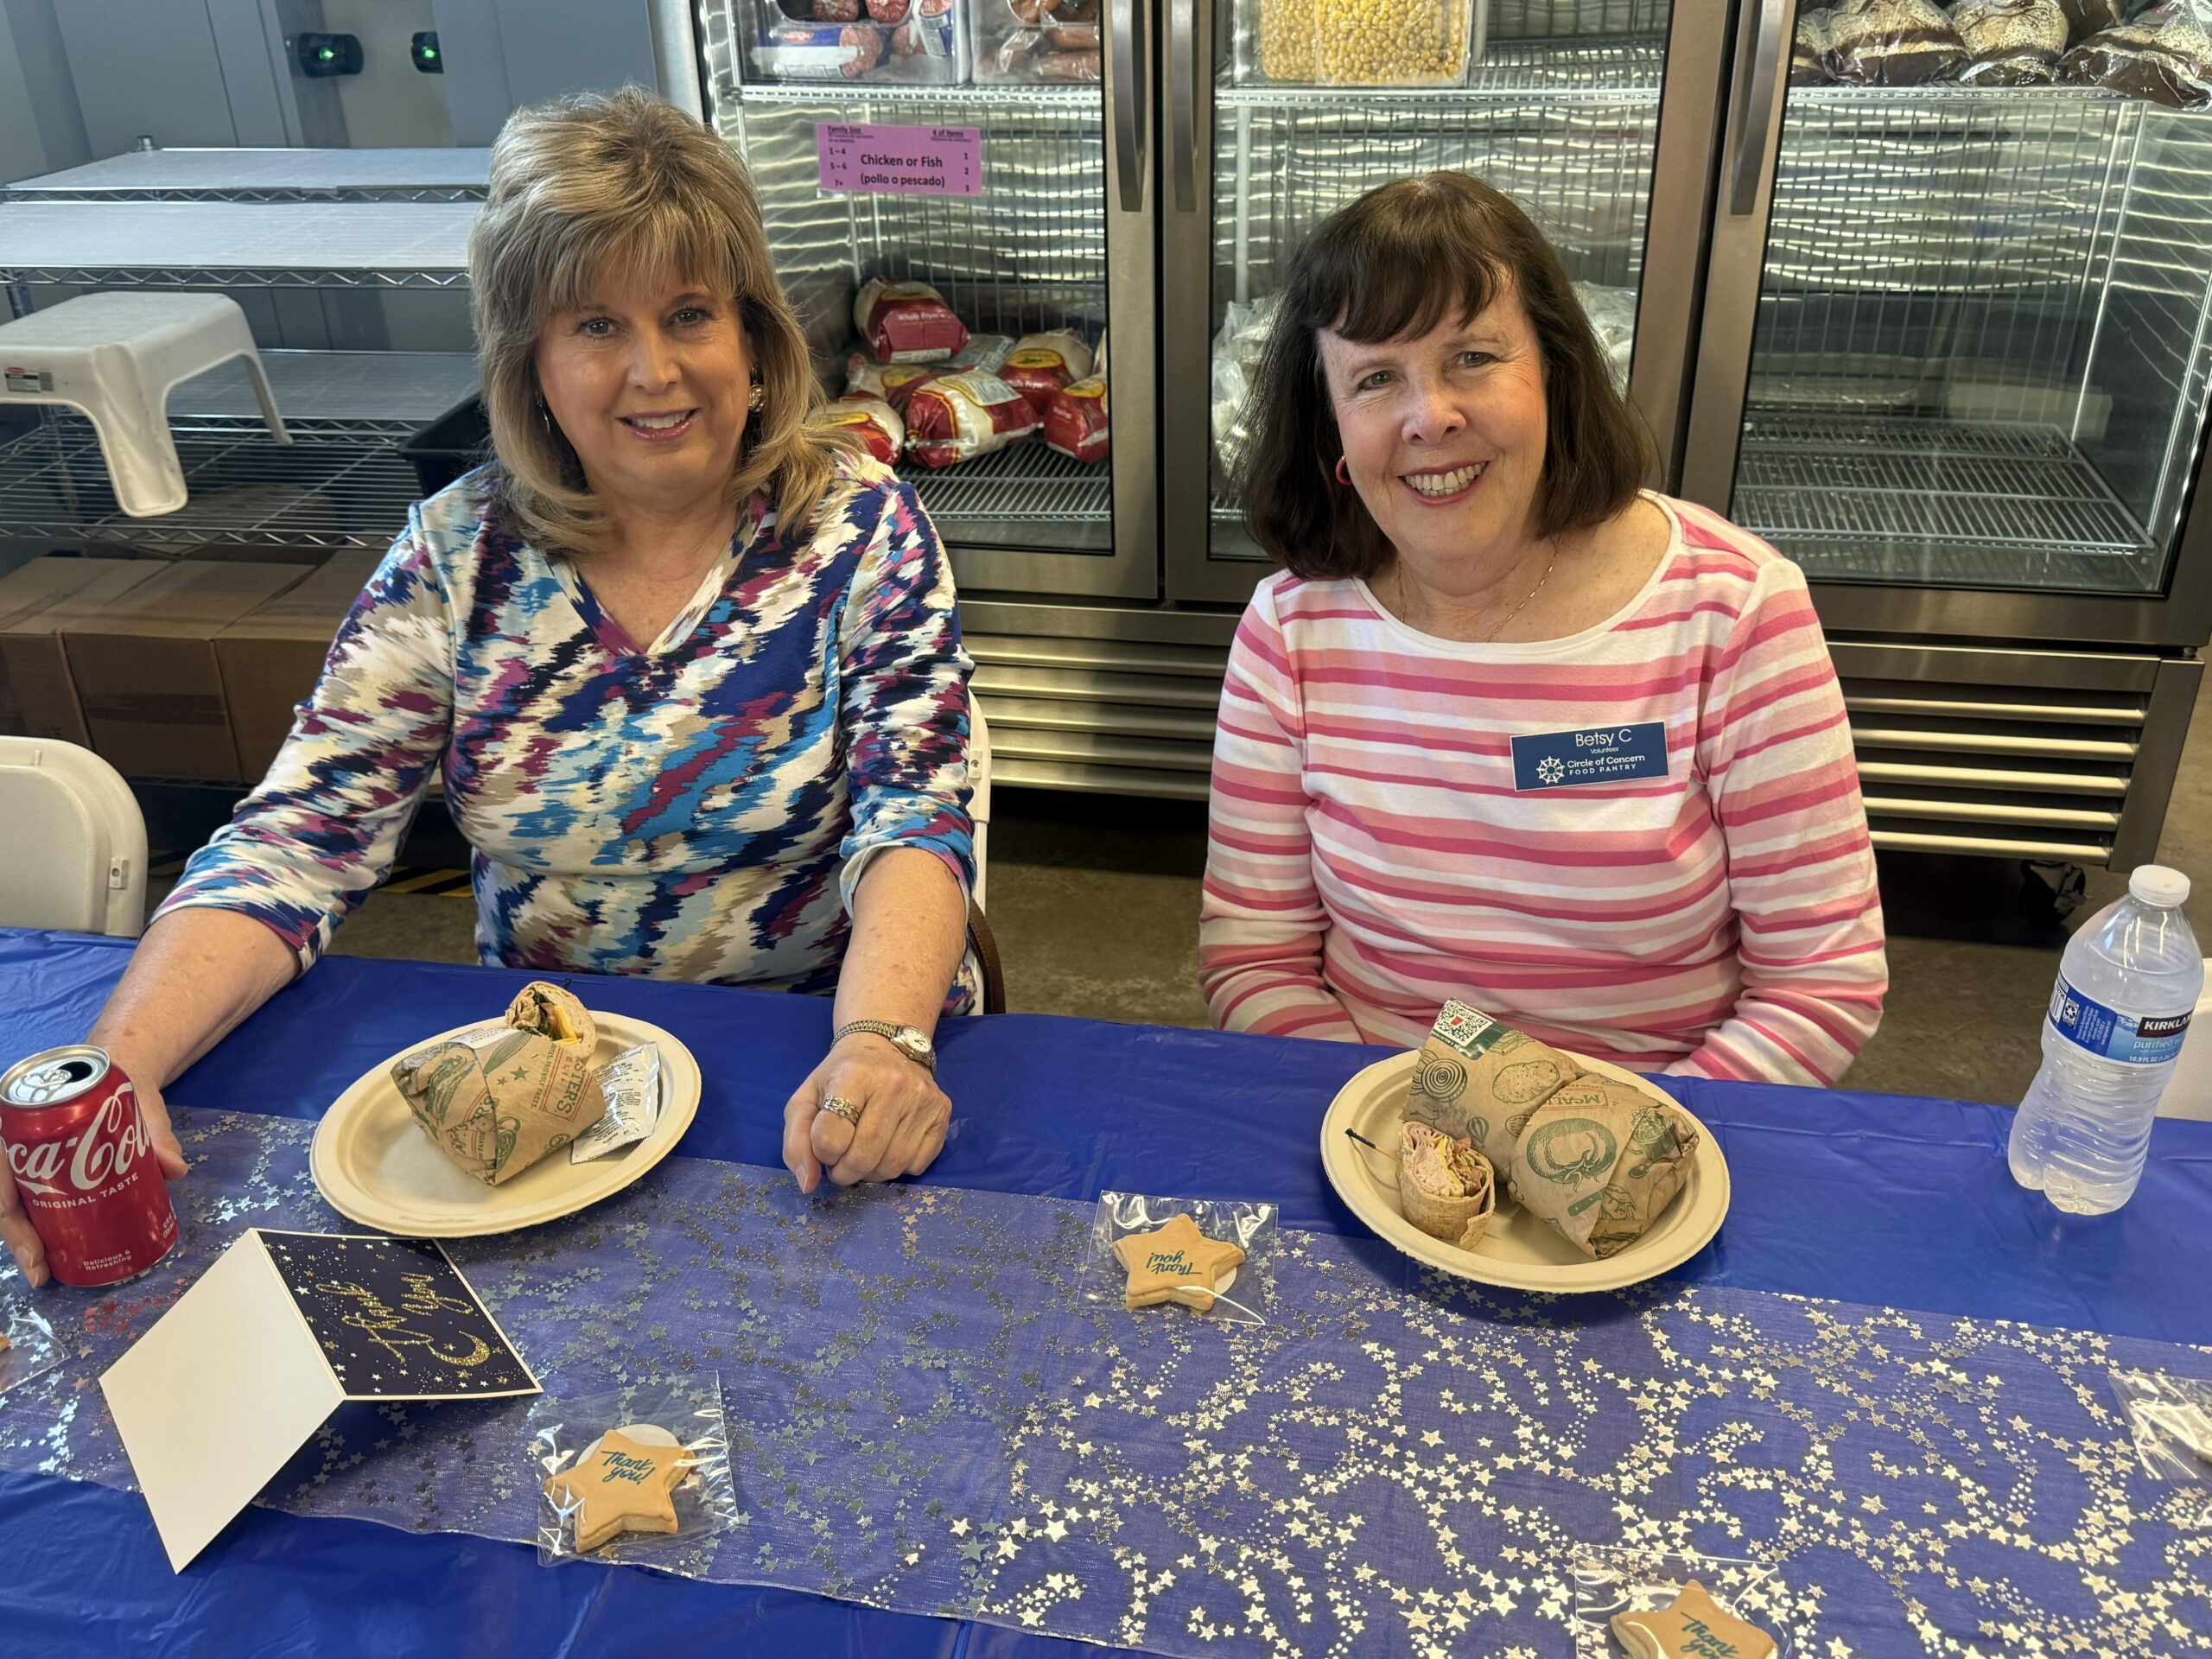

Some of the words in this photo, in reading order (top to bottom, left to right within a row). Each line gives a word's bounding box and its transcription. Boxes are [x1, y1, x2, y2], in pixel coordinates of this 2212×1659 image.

[861, 154, 904, 167] Chicken
[906, 158, 918, 167] or
[921, 156, 943, 168] Fish
[861, 173, 889, 186] (pollo
[900, 175, 945, 188] pescado)
[1575, 732, 1615, 747] Betsy
[1618, 728, 1632, 743] C
[1590, 747, 1619, 755] Volunteer
[1567, 758, 1594, 769] Circle
[1595, 757, 1605, 766] of
[1605, 754, 1646, 765] Concern
[1569, 767, 1595, 776] FOOD
[1599, 764, 1637, 773] PANTRY
[2133, 1037, 2173, 1050] purified
[0, 1082, 150, 1195] ca-Col
[32, 1195, 97, 1210] ORIGINAL
[99, 1172, 139, 1198] TASTE
[83, 1253, 123, 1267] Delicious
[86, 1255, 132, 1271] Refreshing
[1147, 1249, 1185, 1268] you!
[1151, 1262, 1203, 1275] Thank
[601, 1450, 654, 1471] Thank
[601, 1466, 657, 1486] you!
[1680, 1611, 1740, 1659] Thank
[1680, 1638, 1721, 1659] yo
